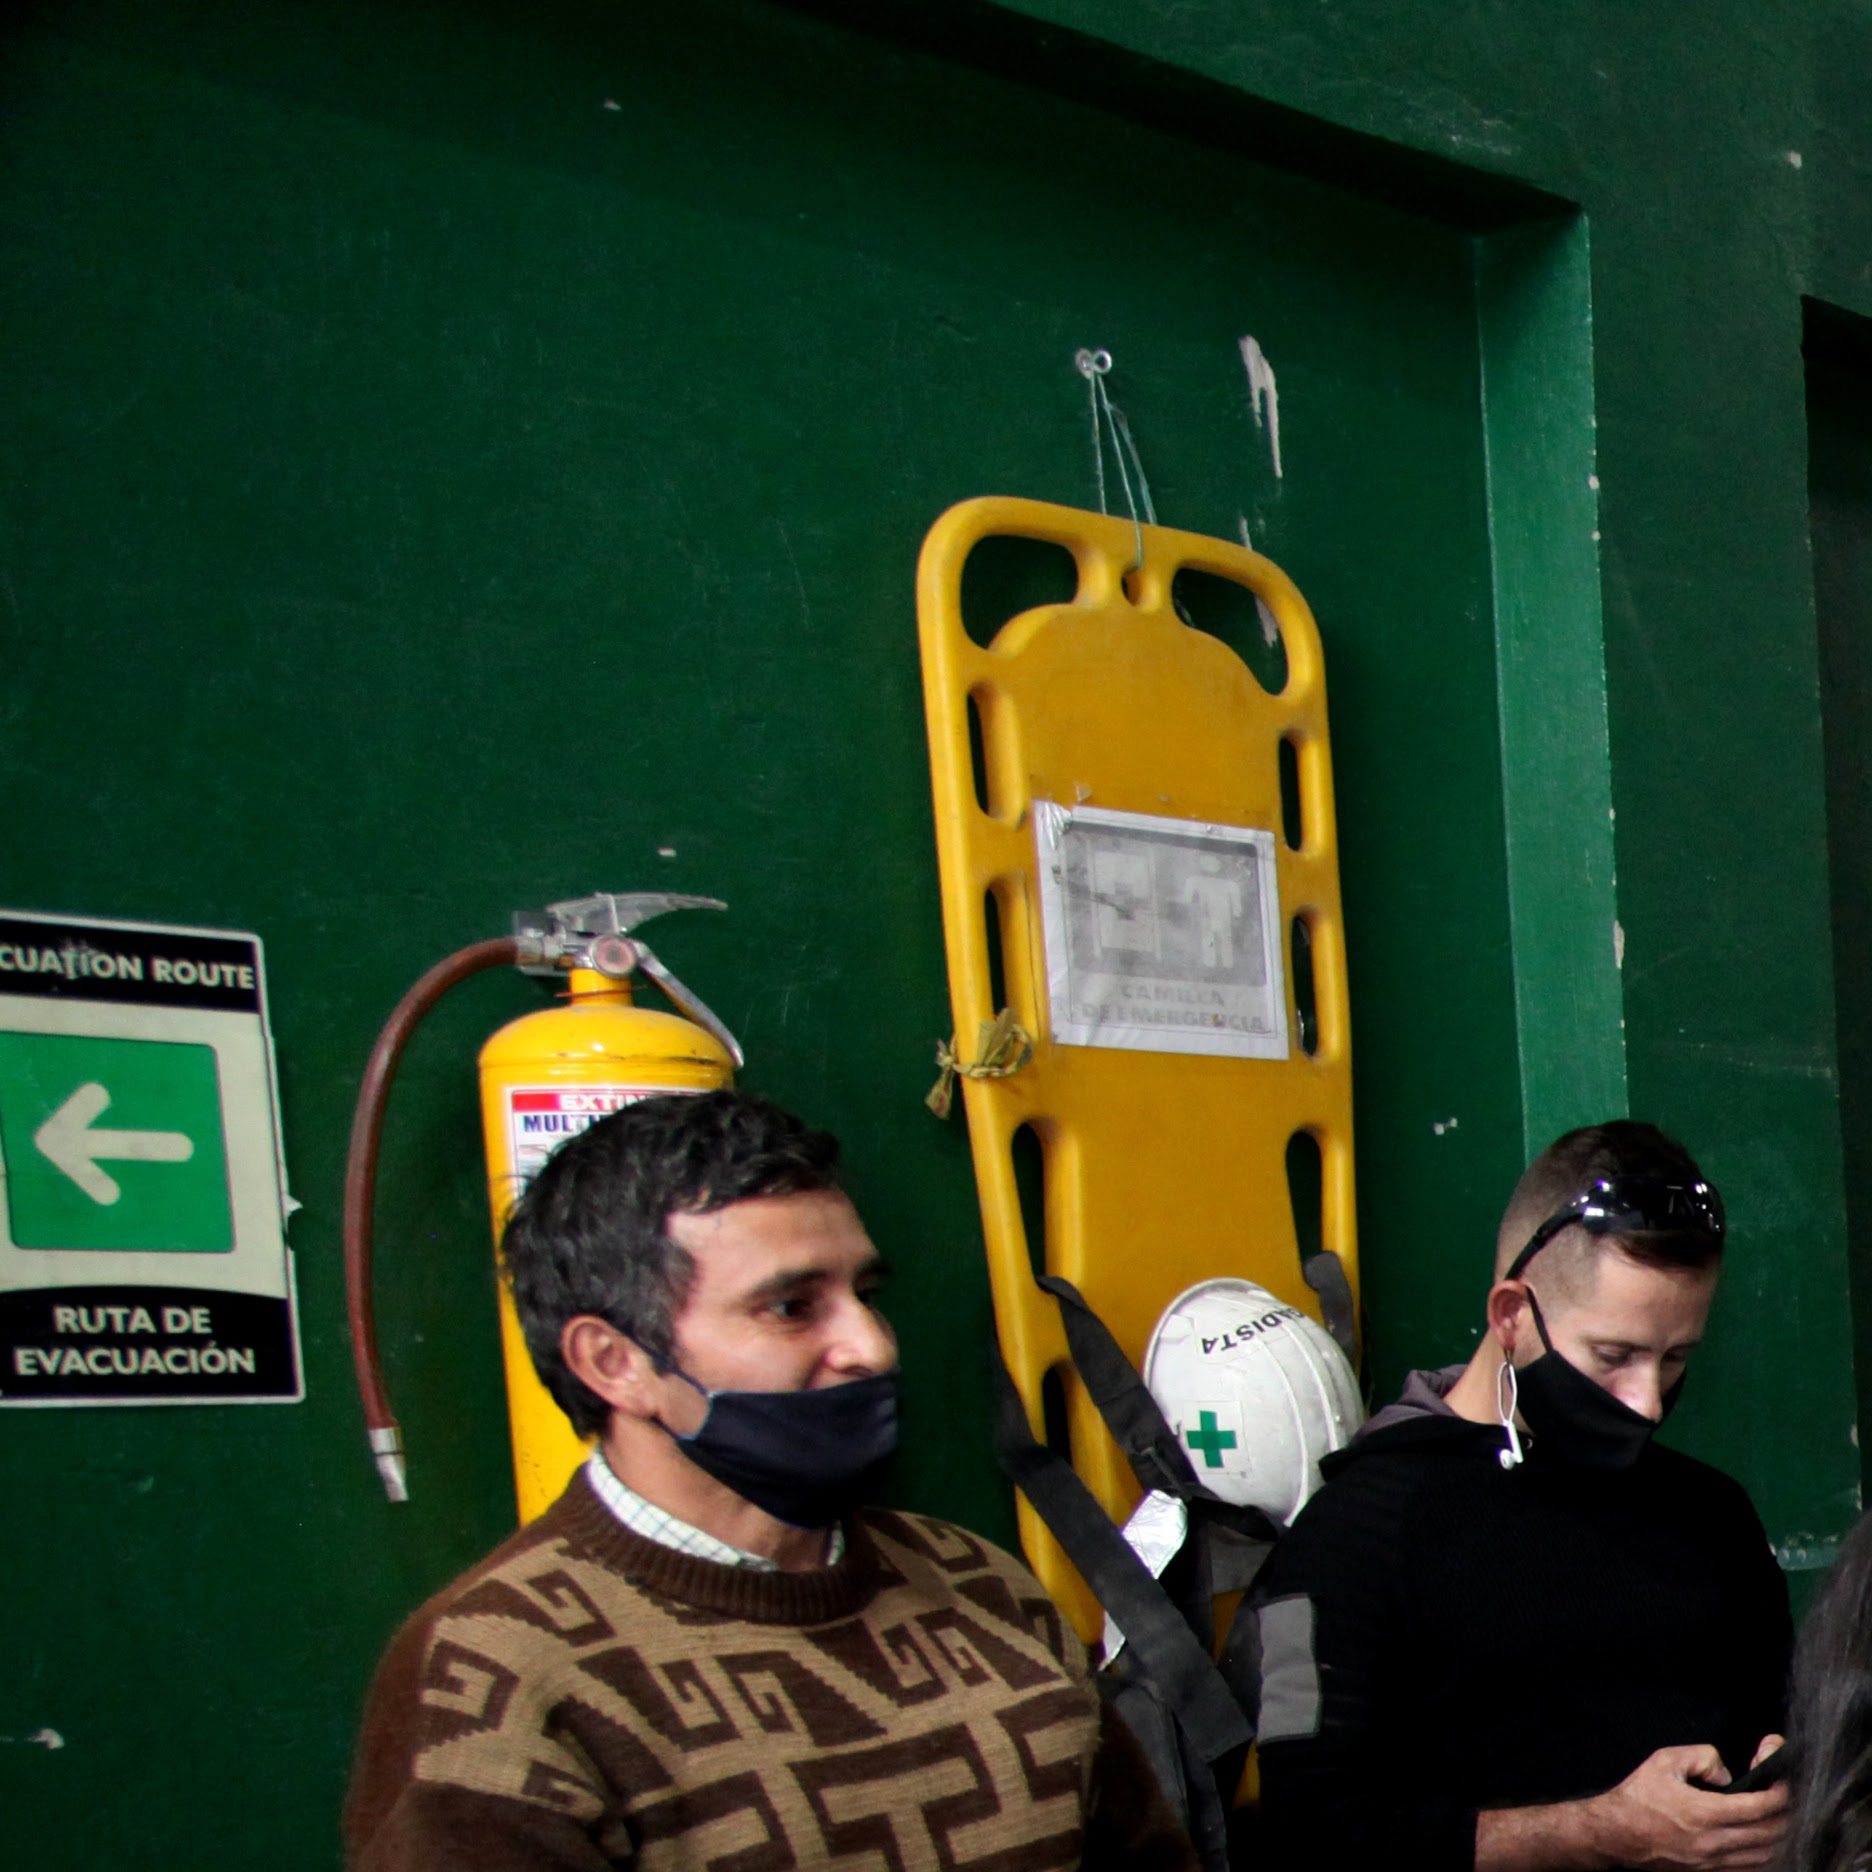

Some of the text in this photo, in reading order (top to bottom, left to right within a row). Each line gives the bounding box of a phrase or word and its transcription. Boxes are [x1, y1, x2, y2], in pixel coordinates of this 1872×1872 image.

[152, 956, 256, 990] ROUTE
[53, 1305, 213, 1334] RUTA DE
[13, 1339, 257, 1376] EVACUACIÓN
